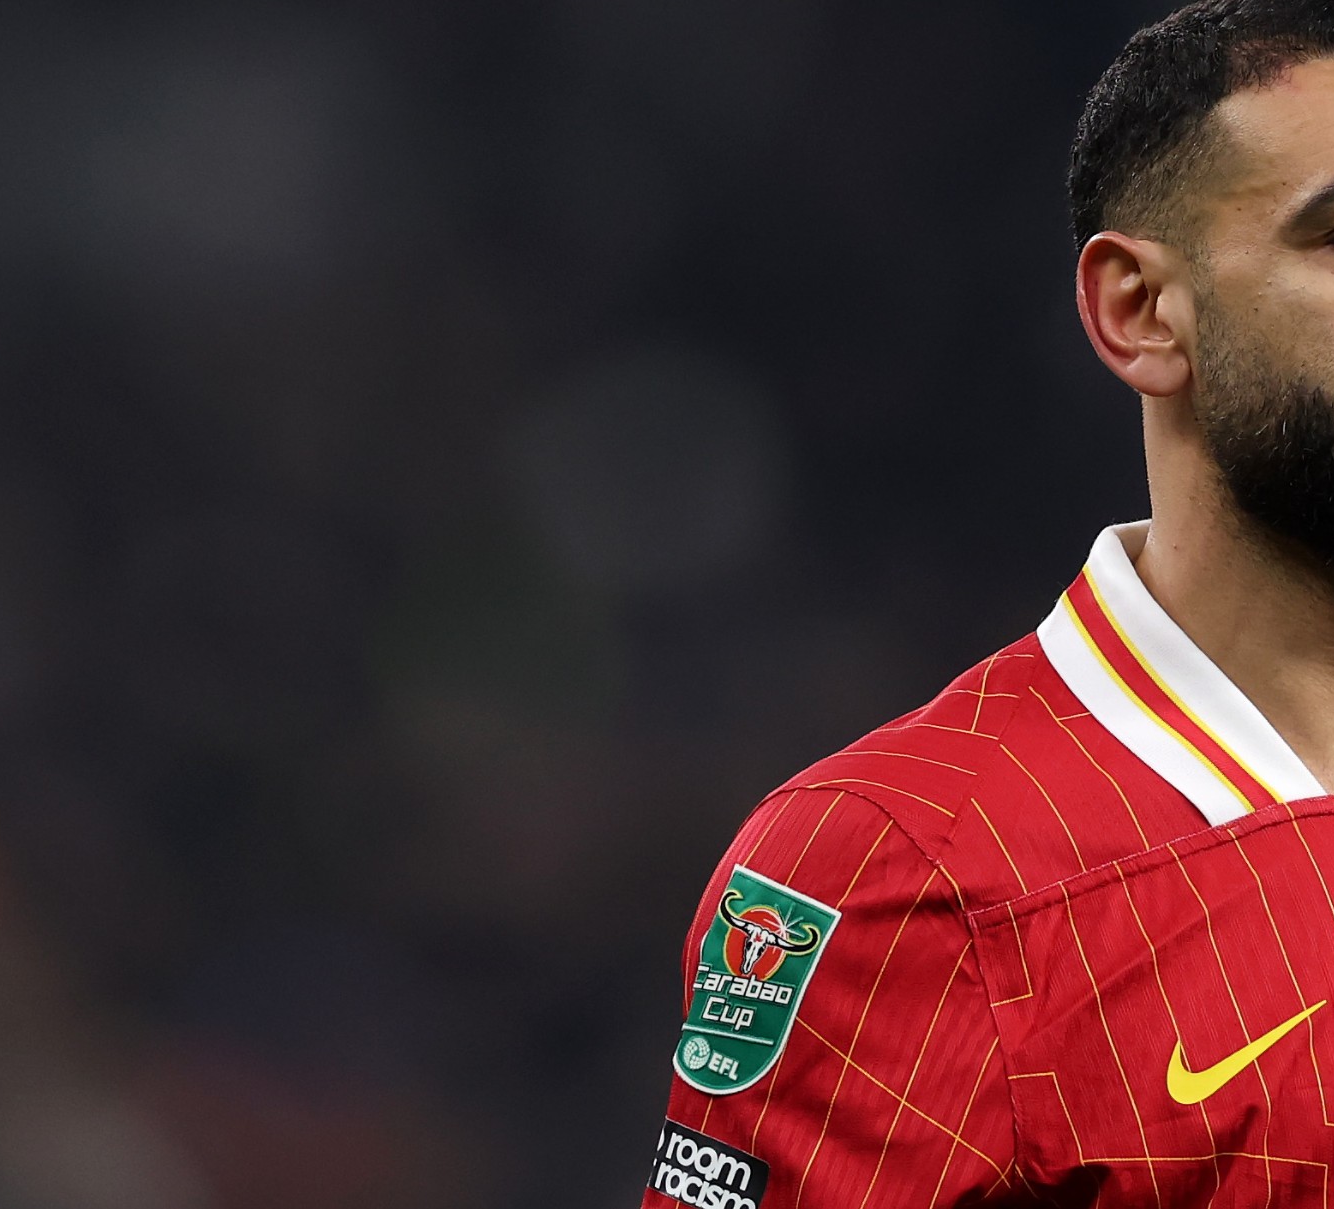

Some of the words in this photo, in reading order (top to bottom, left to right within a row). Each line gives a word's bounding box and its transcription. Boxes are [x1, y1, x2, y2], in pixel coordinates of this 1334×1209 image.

[693, 965, 793, 1005] Carabao
[702, 996, 754, 1030] Cup
[708, 1052, 739, 1081] EFL
[665, 1132, 751, 1191] room
